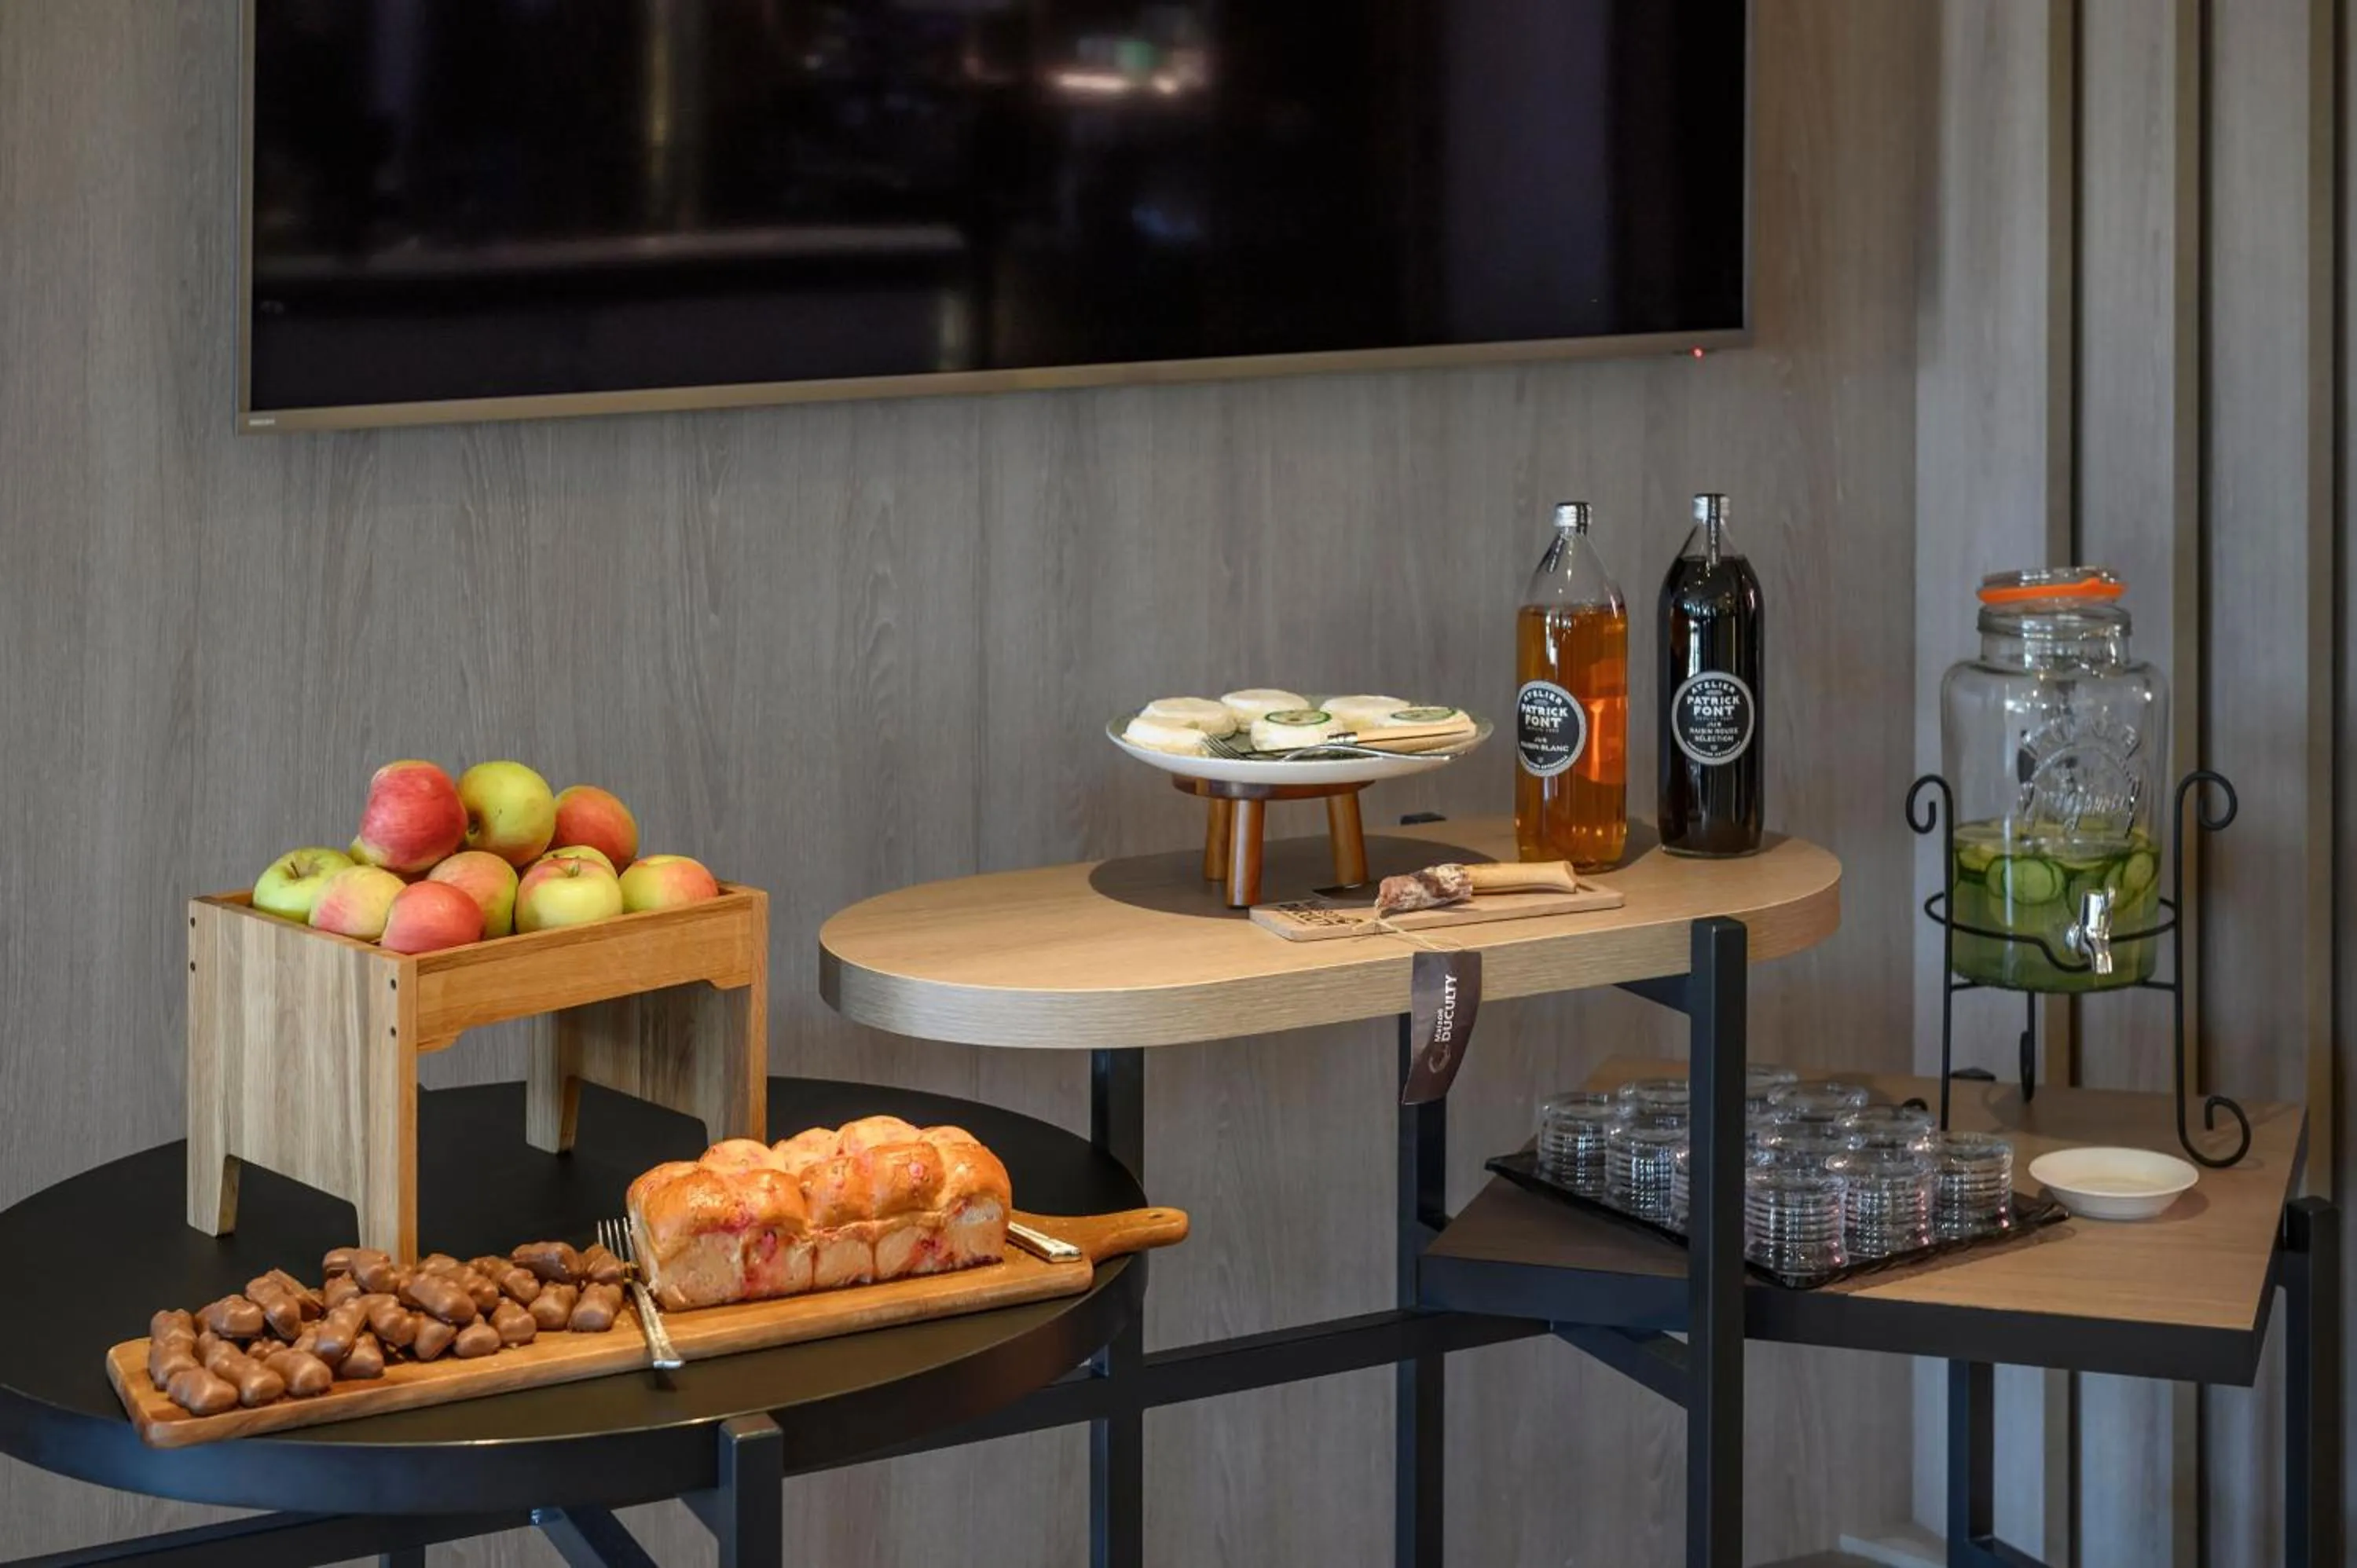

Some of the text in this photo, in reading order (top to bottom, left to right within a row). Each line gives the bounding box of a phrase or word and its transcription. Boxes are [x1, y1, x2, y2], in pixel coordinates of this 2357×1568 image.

[1692, 681, 1736, 694] ATELIER
[1523, 689, 1563, 705] ATELIER
[1686, 695, 1740, 705] PATRICK
[1521, 703, 1568, 717] PATRICK
[1693, 705, 1735, 716] FONT
[1525, 715, 1562, 728] FONT
[1441, 974, 1457, 1042] DUCULTY
